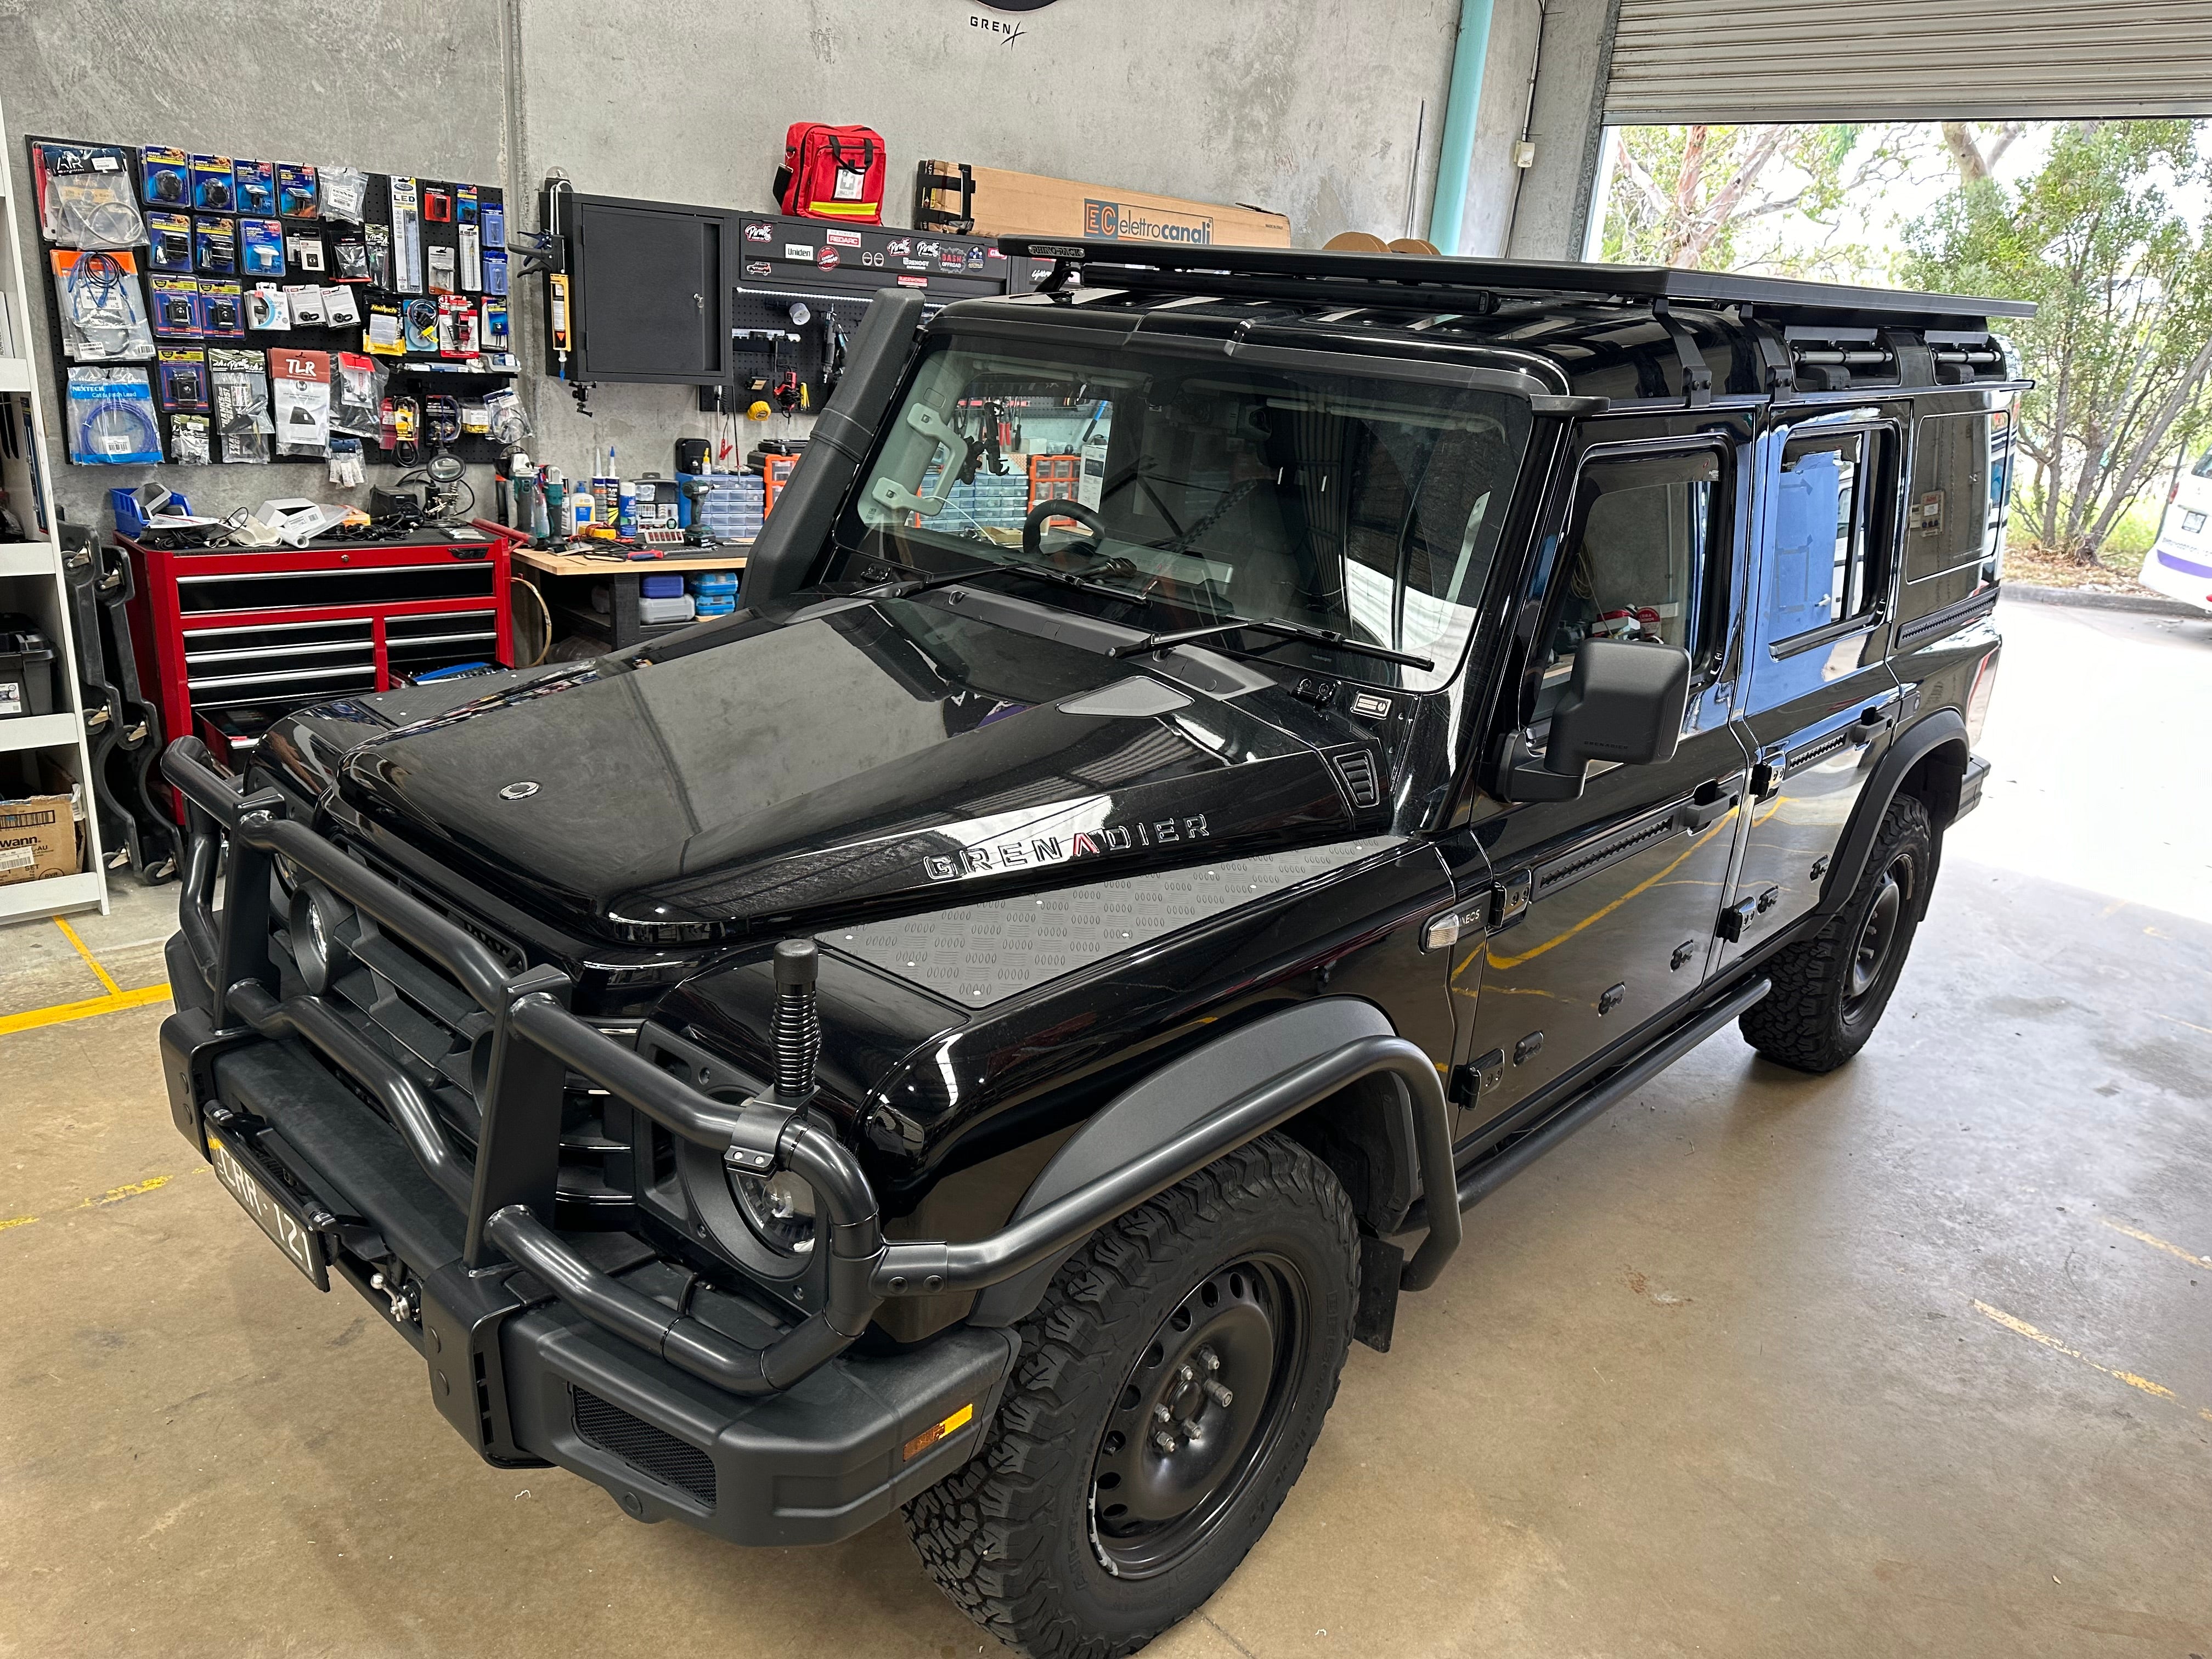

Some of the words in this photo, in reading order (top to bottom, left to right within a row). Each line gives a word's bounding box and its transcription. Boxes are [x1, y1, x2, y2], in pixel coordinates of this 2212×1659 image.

[1119, 210, 1210, 244] elettrocanali
[830, 236, 858, 245] REDARC
[788, 248, 810, 257] Uniden
[1031, 246, 1081, 256] RHINO-RACK
[942, 253, 962, 263] DASH
[286, 359, 317, 377] TLR
[0, 836, 37, 848] wann
[923, 814, 1210, 879] GRENADIER
[1459, 909, 1480, 927] INEOS
